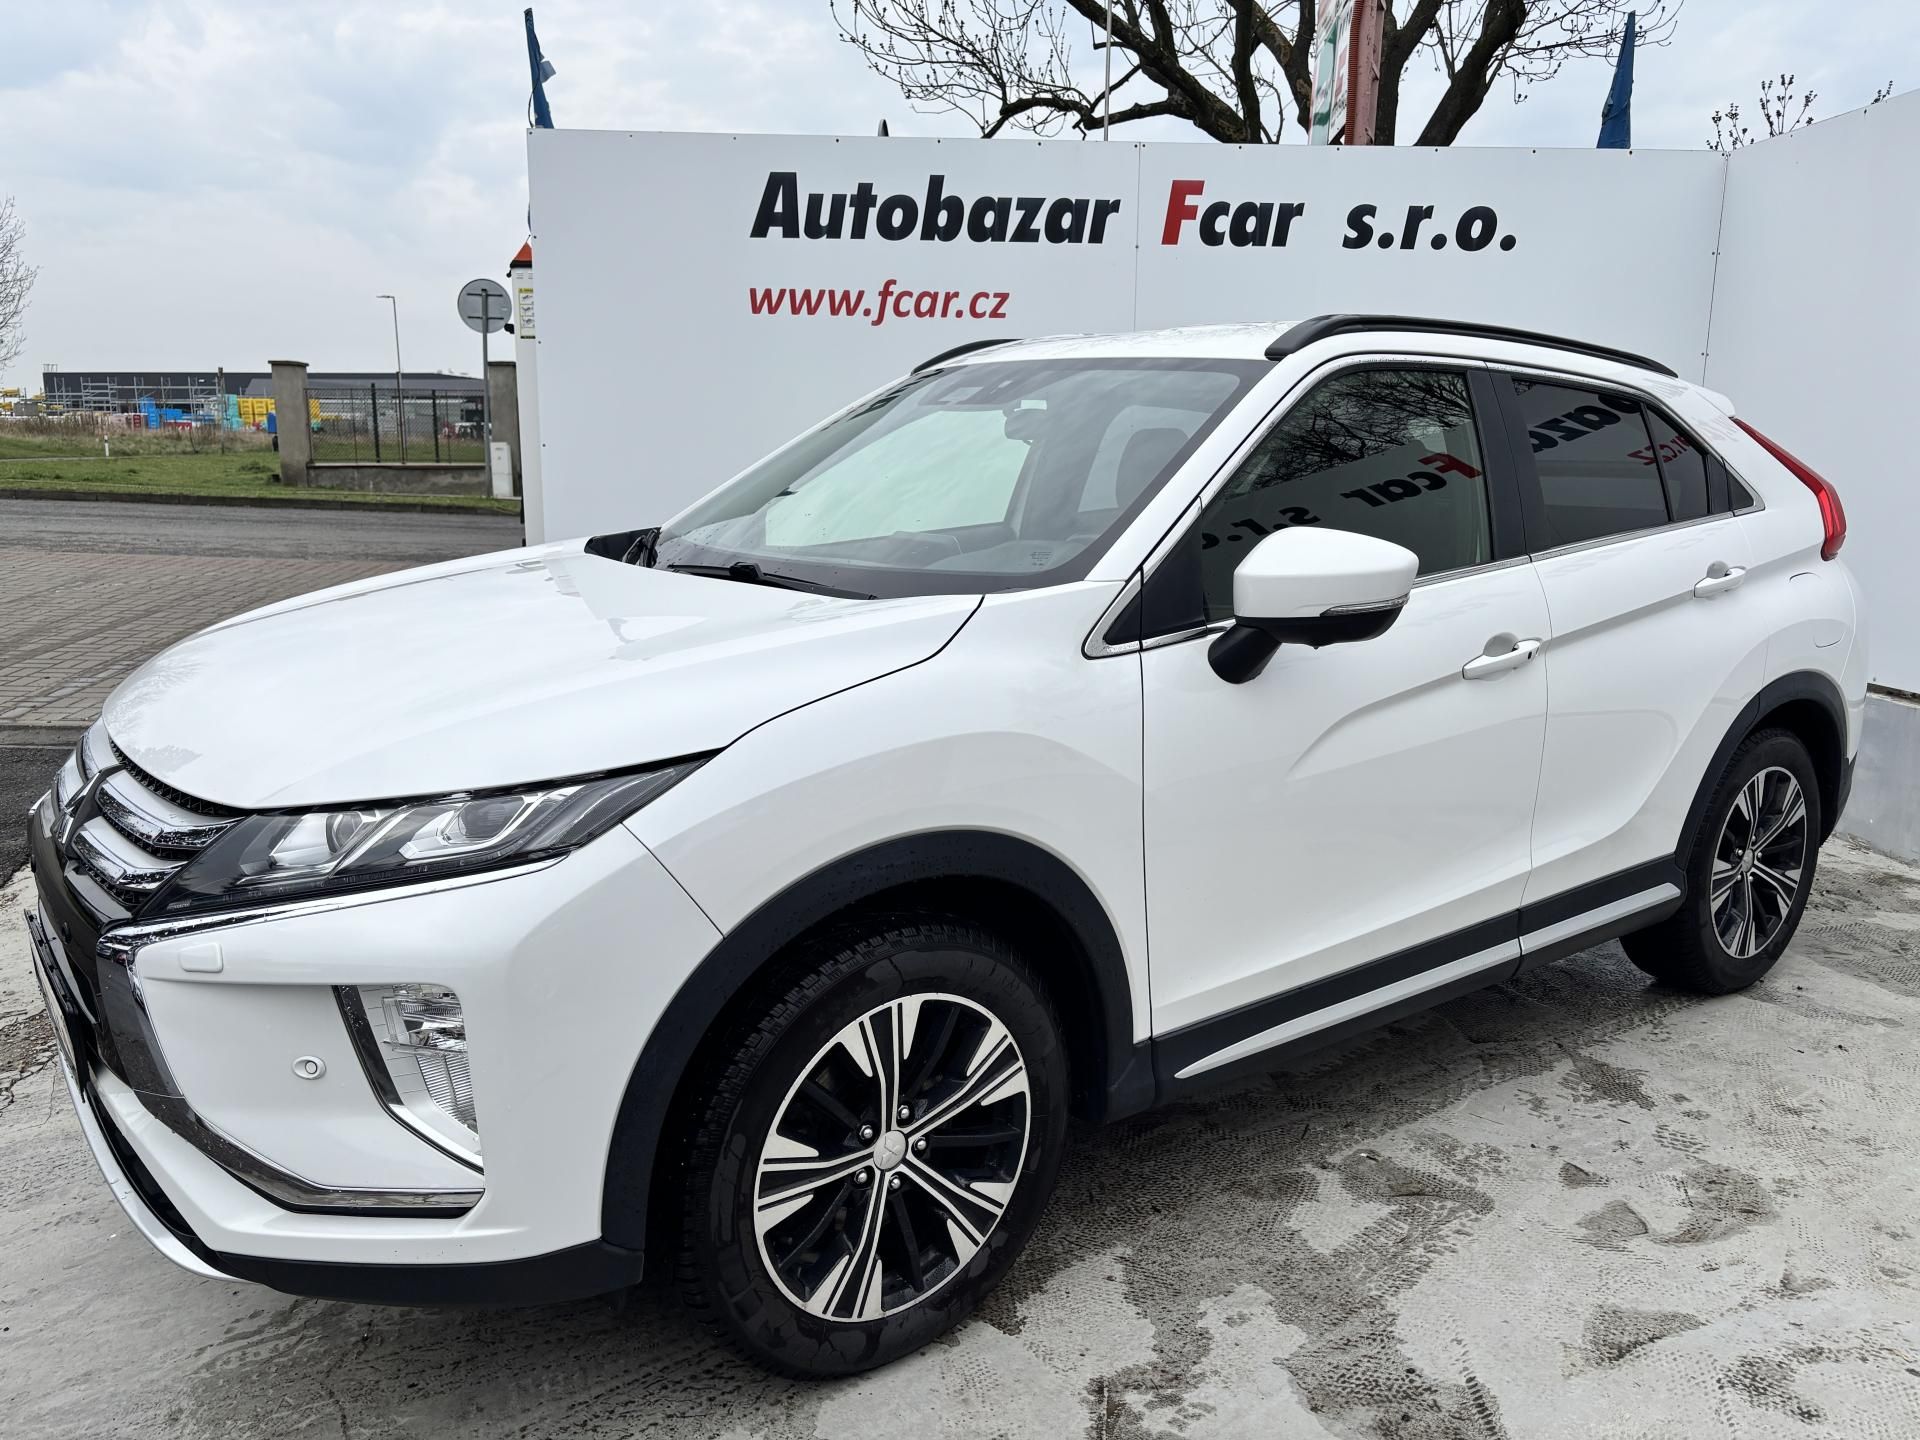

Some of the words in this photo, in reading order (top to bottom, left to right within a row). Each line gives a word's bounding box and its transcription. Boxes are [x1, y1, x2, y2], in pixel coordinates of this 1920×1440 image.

[750, 171, 1122, 245] Autobazar
[1161, 179, 1306, 248] Fcar
[1341, 203, 1517, 252] s.r.o.
[749, 278, 1011, 327] www.fcar.cz
